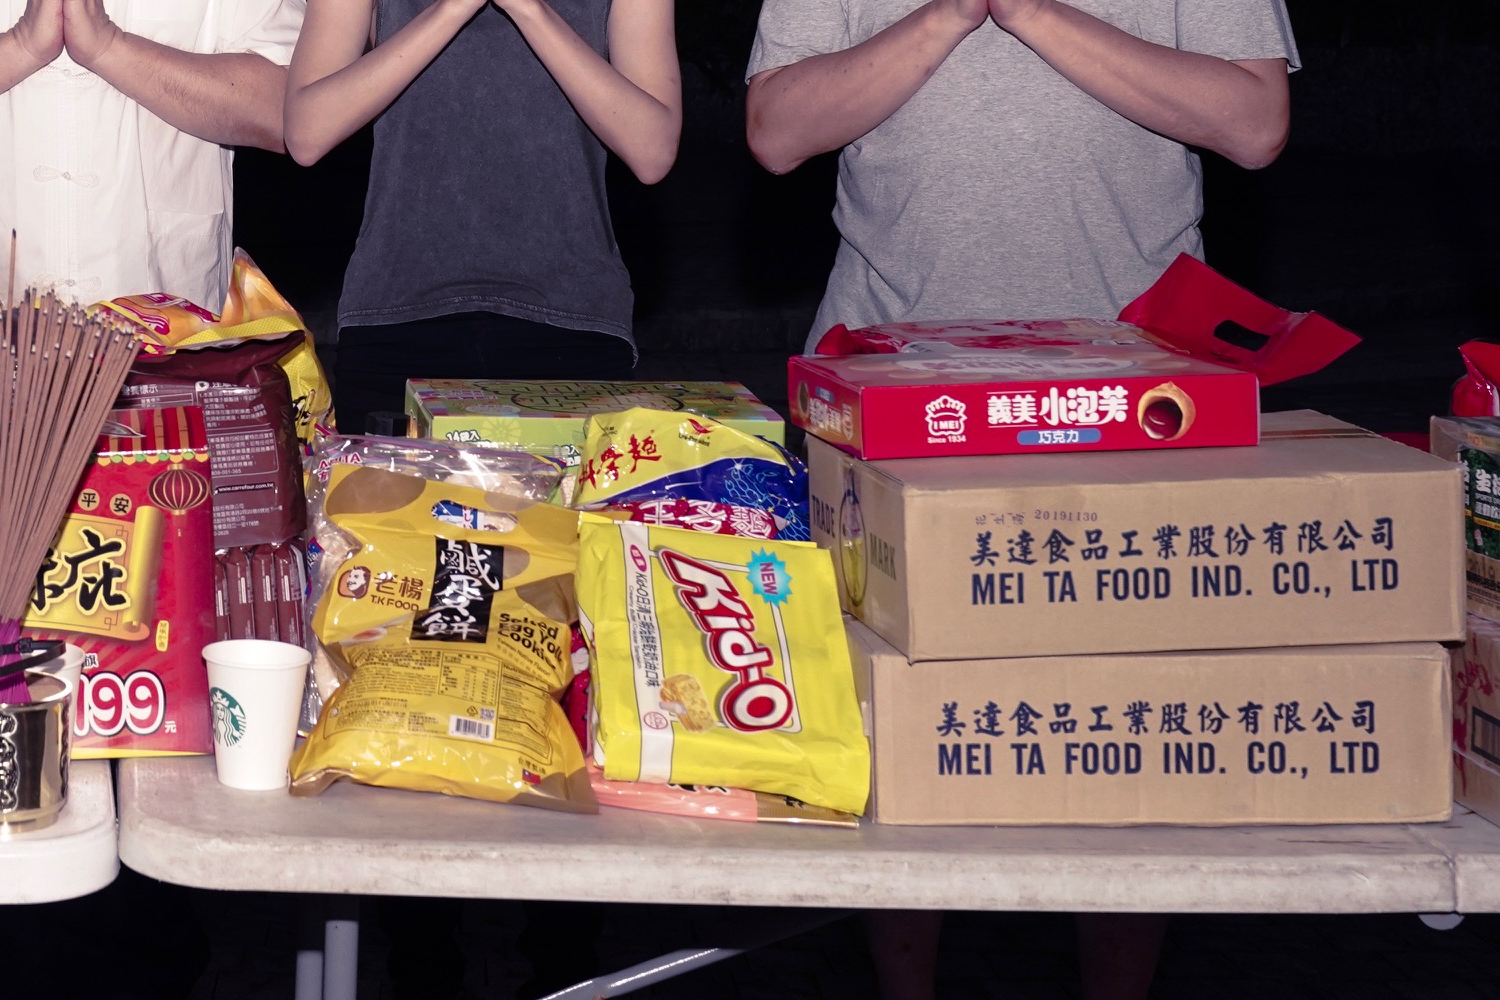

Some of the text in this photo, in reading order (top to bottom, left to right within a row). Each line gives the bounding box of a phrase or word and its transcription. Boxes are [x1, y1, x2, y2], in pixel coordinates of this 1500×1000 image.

[987, 385, 1129, 425] 義美 小泡芙
[927, 435, 967, 444] Since 1934
[1038, 429, 1079, 444] 巧克力
[1034, 509, 1098, 522] 20191130
[812, 494, 896, 581] TRADE MARK
[970, 517, 1397, 567] 美達食品工業股份有限公司
[374, 572, 425, 601] 老楊
[422, 539, 500, 640] 鹹蛋餅
[760, 562, 778, 596] NEW
[971, 558, 1400, 606] MEI TA FOOD IND. CO., LTD
[660, 550, 793, 731] Kid-O
[164, 721, 177, 733] 元
[934, 700, 1377, 737] 美達食品工業股份有限公司
[937, 739, 1381, 780] MEI TA FOOD IND. CO., LTD
